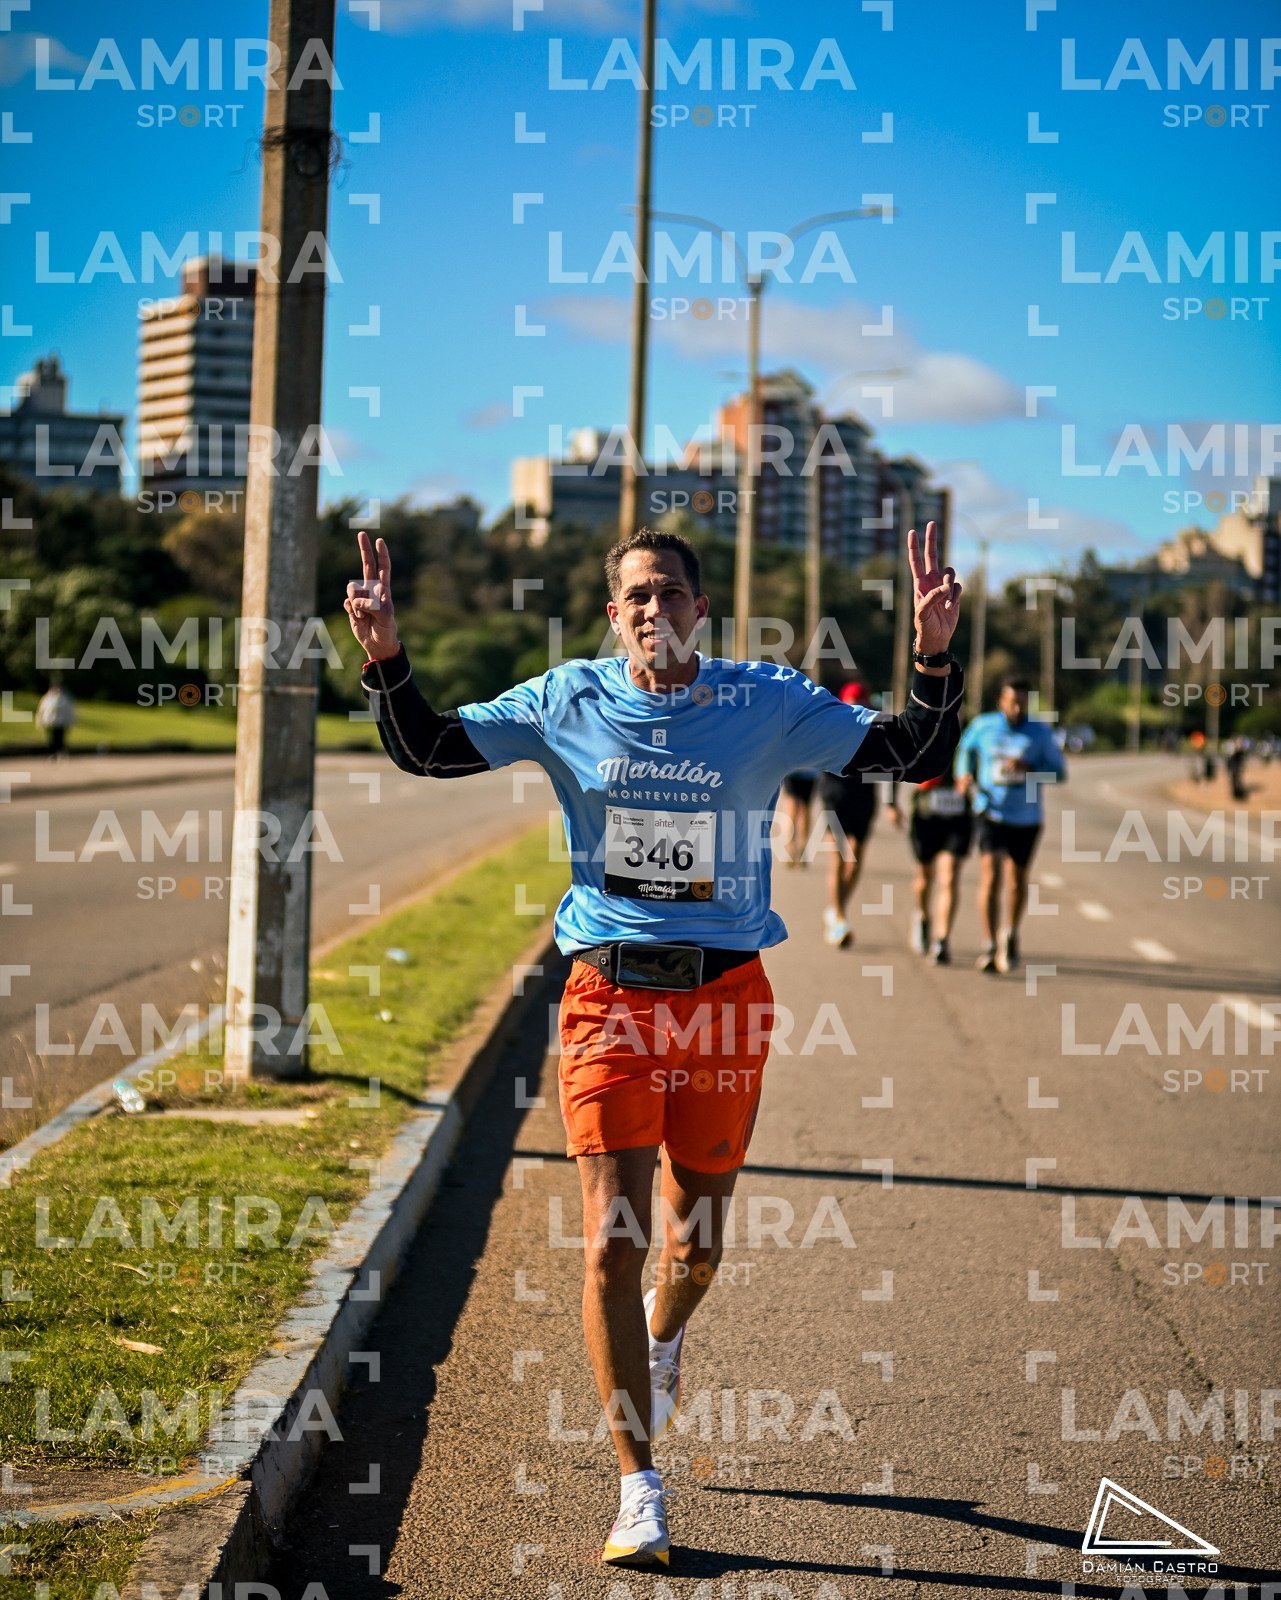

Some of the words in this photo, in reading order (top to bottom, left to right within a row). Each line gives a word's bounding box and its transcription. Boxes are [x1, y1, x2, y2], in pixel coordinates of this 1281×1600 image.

[596, 755, 723, 788] Maratón
[608, 789, 711, 802] MONTEVIDEO
[624, 836, 694, 871] 346
